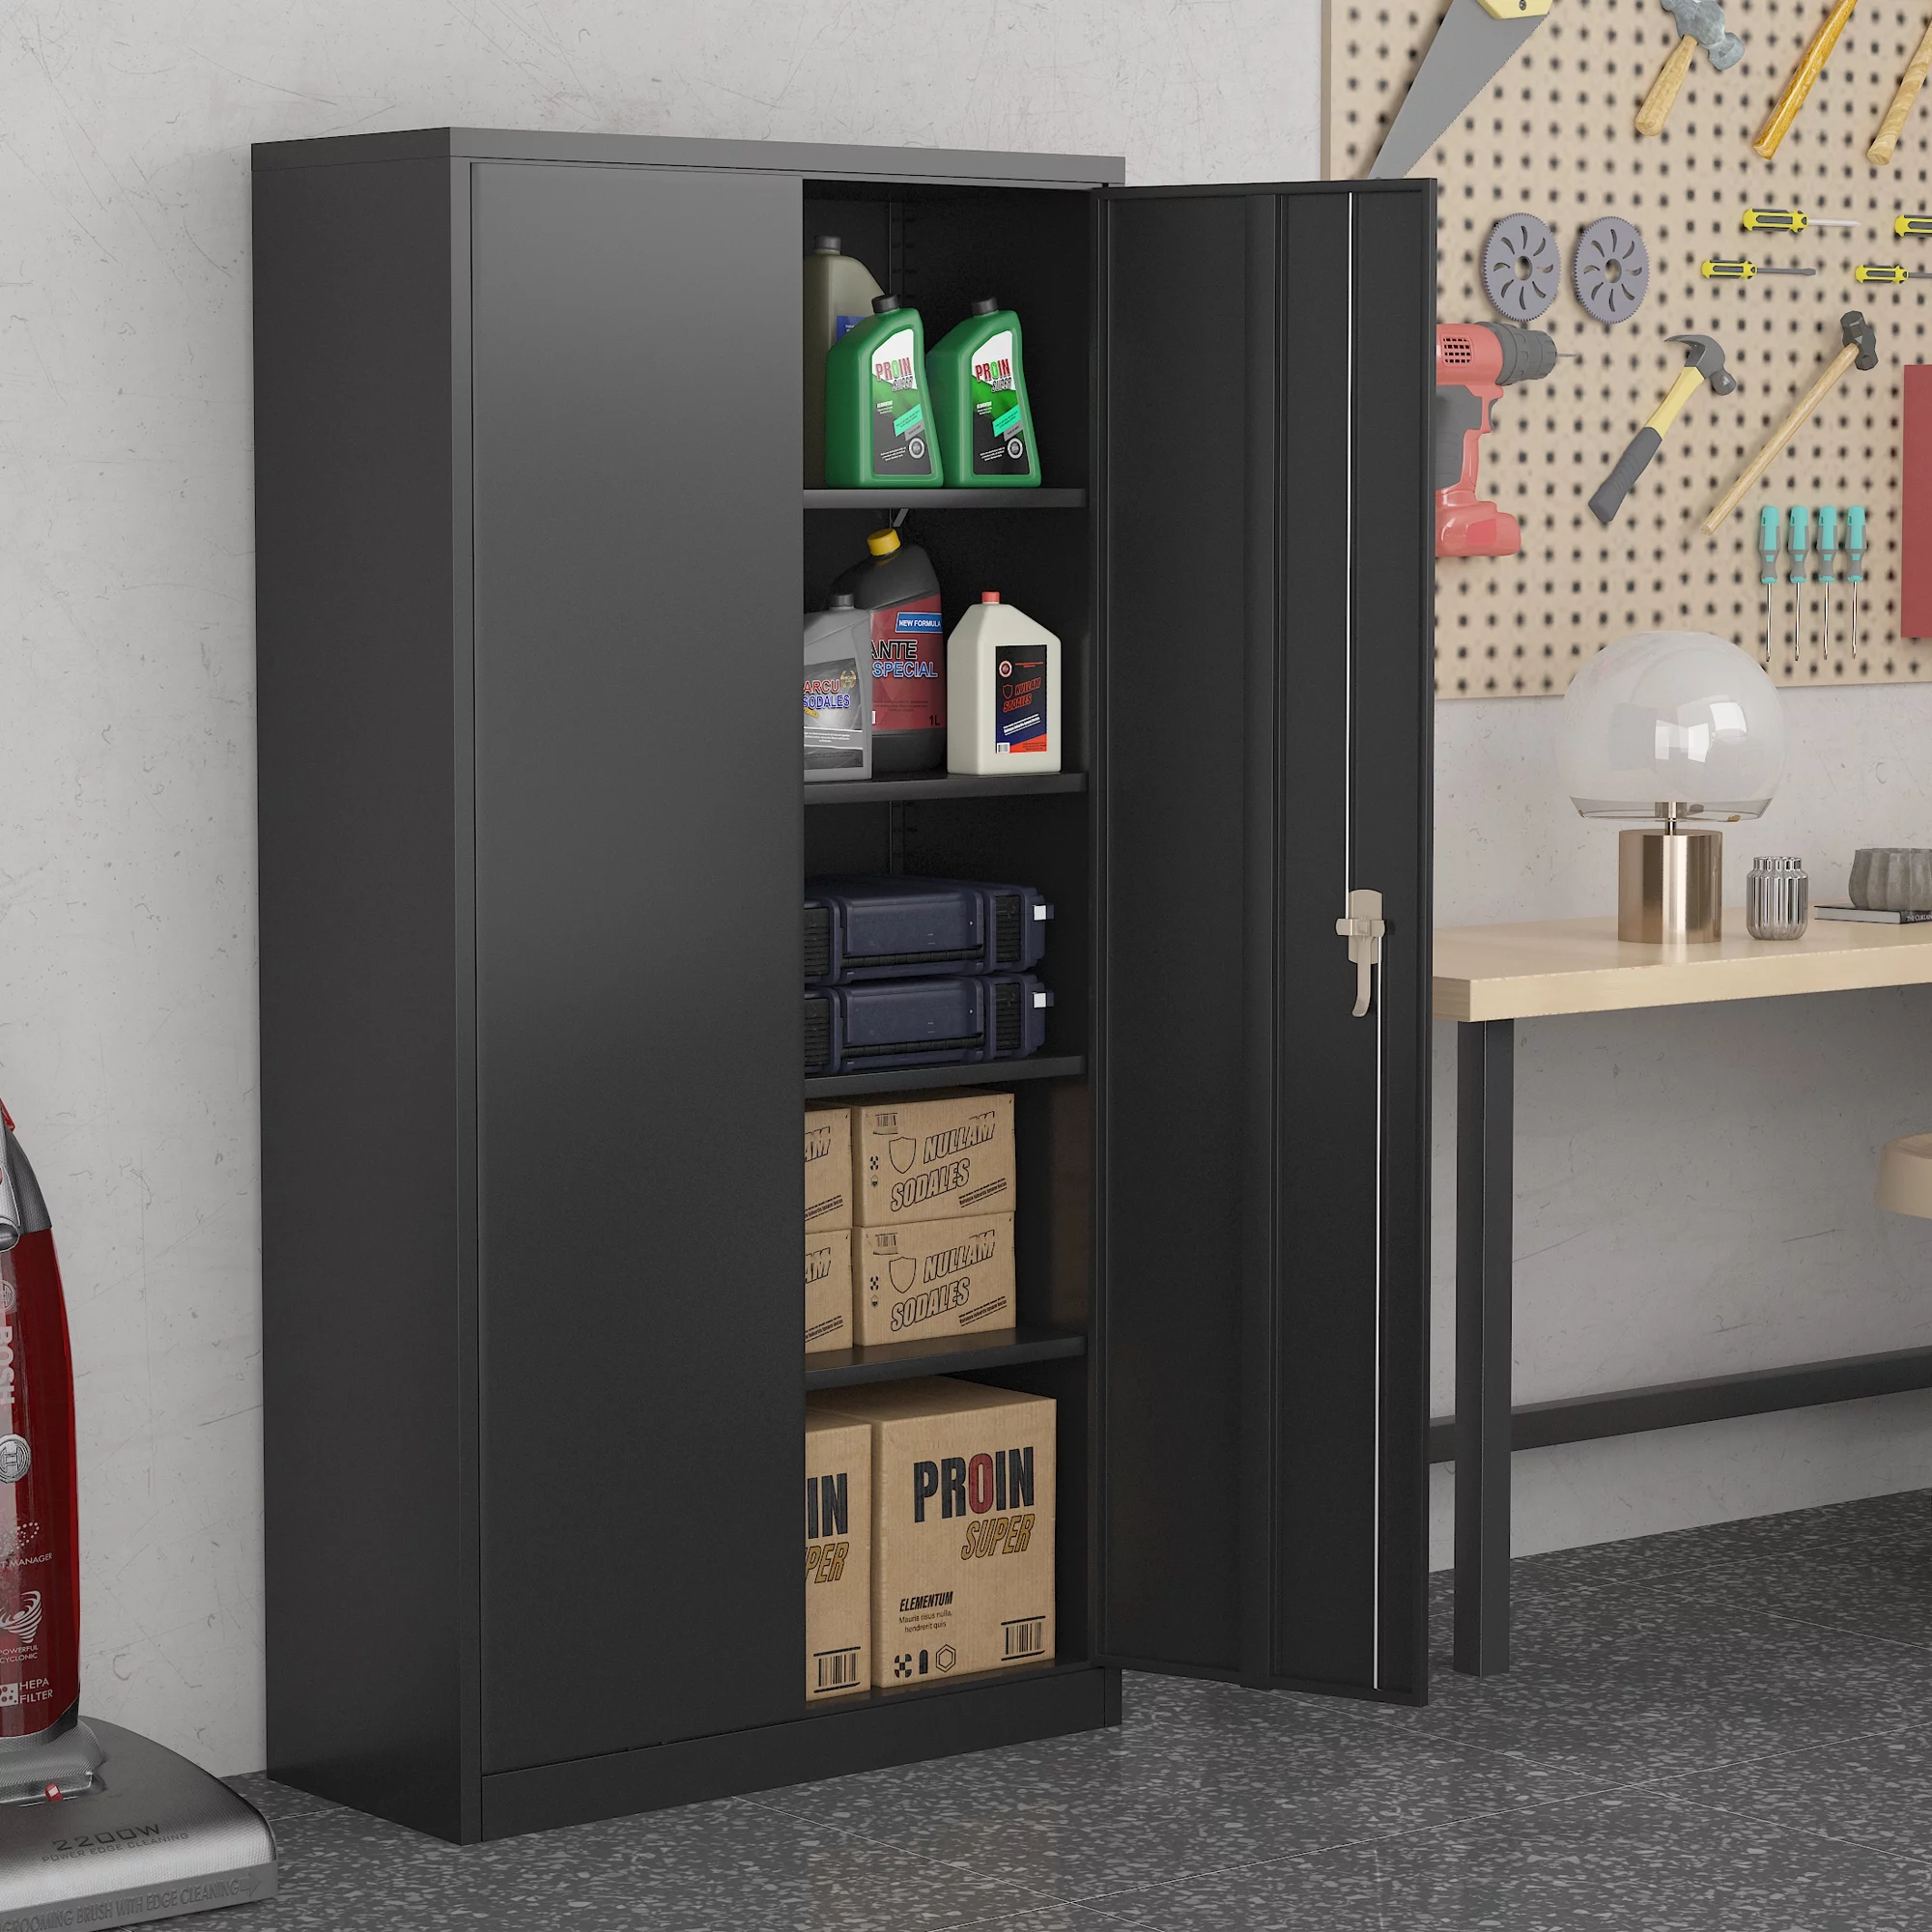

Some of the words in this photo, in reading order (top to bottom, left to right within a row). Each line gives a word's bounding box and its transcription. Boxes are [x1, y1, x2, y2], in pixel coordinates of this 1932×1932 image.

[875, 357, 912, 382] PROIN
[975, 358, 1011, 383] PROIN
[893, 376, 914, 392] SUPER
[991, 377, 1012, 393] SUPER
[914, 619, 942, 628] FORMULA
[872, 661, 939, 678] SPECIAL
[804, 679, 840, 695] ARCU
[928, 715, 941, 725] 1L
[923, 1110, 996, 1165] NULLAM
[890, 1157, 971, 1212] SODALES
[923, 1229, 996, 1284] NULLAM
[890, 1276, 971, 1332] SODALES
[913, 1446, 1035, 1523] PROIN
[960, 1513, 1036, 1561] SUPER
[9, 1552, 53, 1567] MANAGER
[805, 1542, 850, 1584] PER
[899, 1591, 953, 1612] ELEMENTUM
[0, 1652, 38, 1663] CYCLONIC
[19, 1677, 49, 1690] HEPA
[19, 1689, 53, 1704] FILTER
[42, 1849, 87, 1863] POWER
[90, 1843, 125, 1855] EDGE
[128, 1832, 189, 1849] CLEANING
[52, 1824, 160, 1852] 2200W
[76, 1899, 113, 1924] BRUSH
[115, 1894, 144, 1918] WITH
[146, 1889, 178, 1912] EDGE
[180, 1879, 241, 1905] CLEANING
